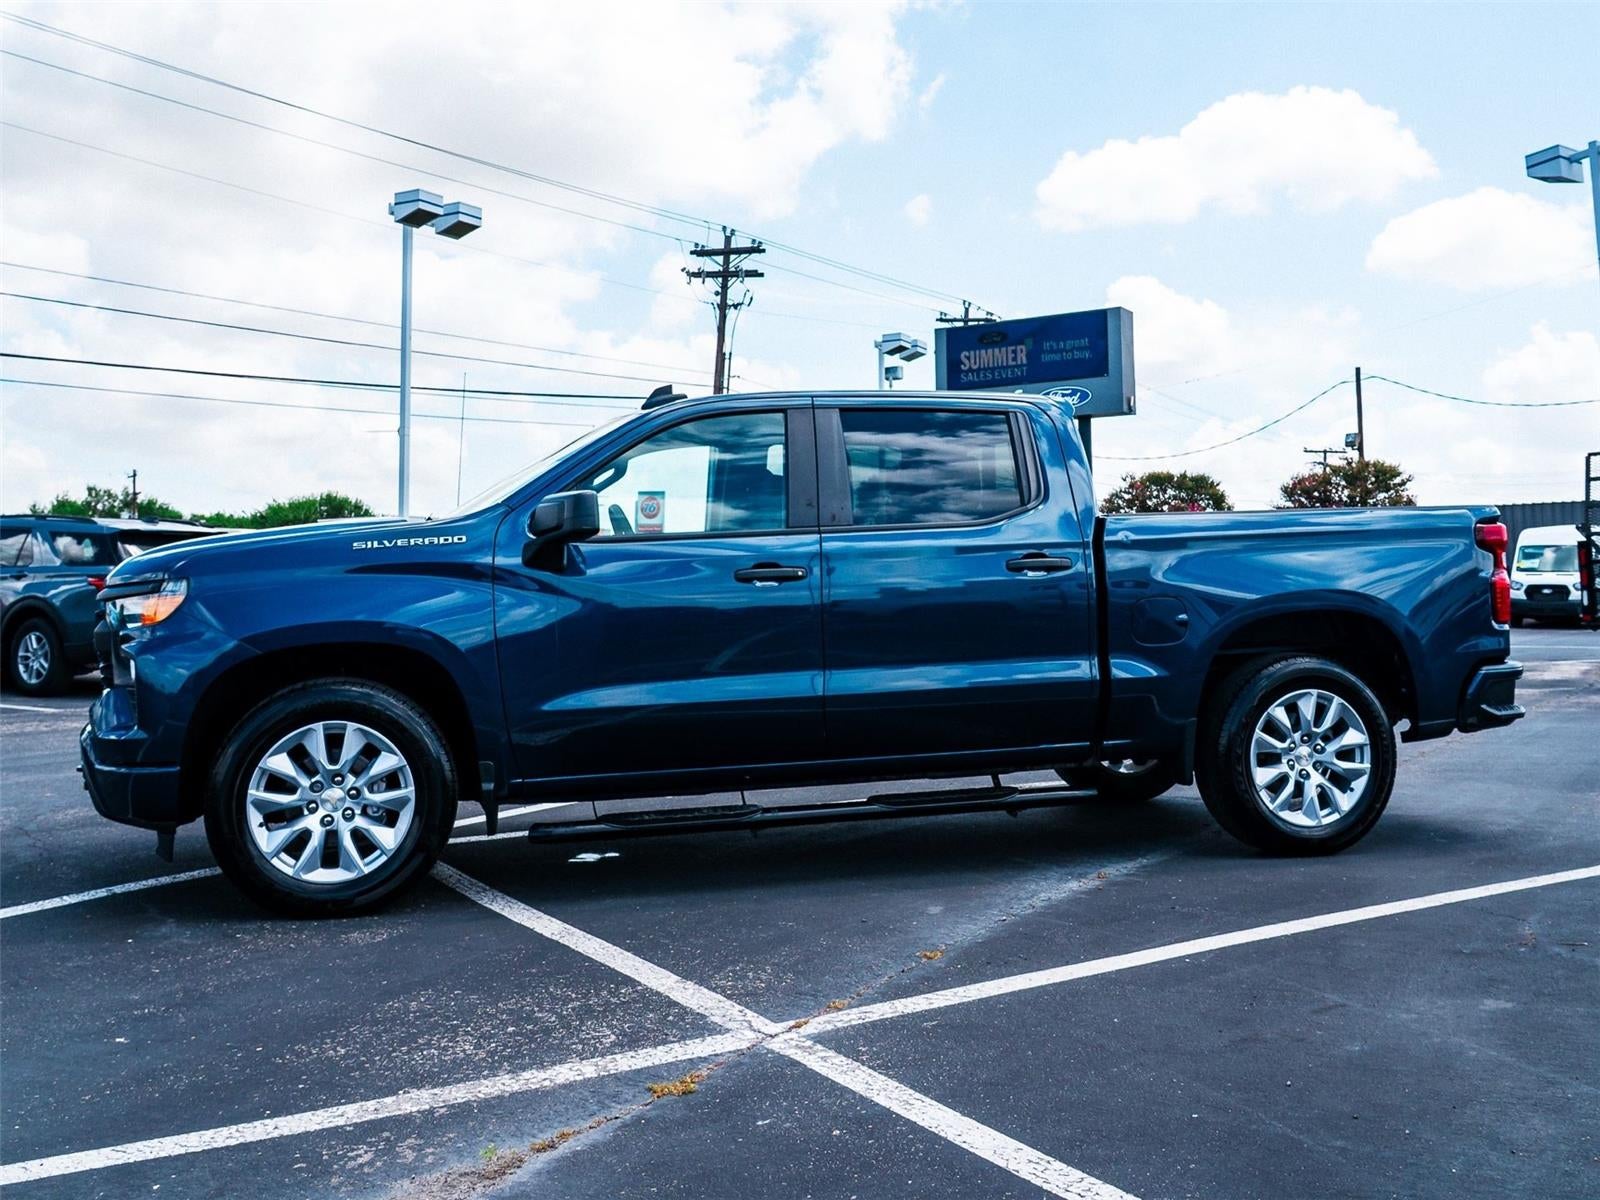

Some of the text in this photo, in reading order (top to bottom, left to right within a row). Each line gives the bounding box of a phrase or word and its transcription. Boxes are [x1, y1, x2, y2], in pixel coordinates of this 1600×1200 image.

[1059, 341, 1064, 349] a
[1065, 337, 1089, 350] great
[960, 345, 1027, 370] SUMMER
[1041, 352, 1061, 361] time
[1063, 351, 1072, 360] to
[960, 367, 1028, 382] SALES EVENT
[352, 535, 467, 550] SILVERADO
